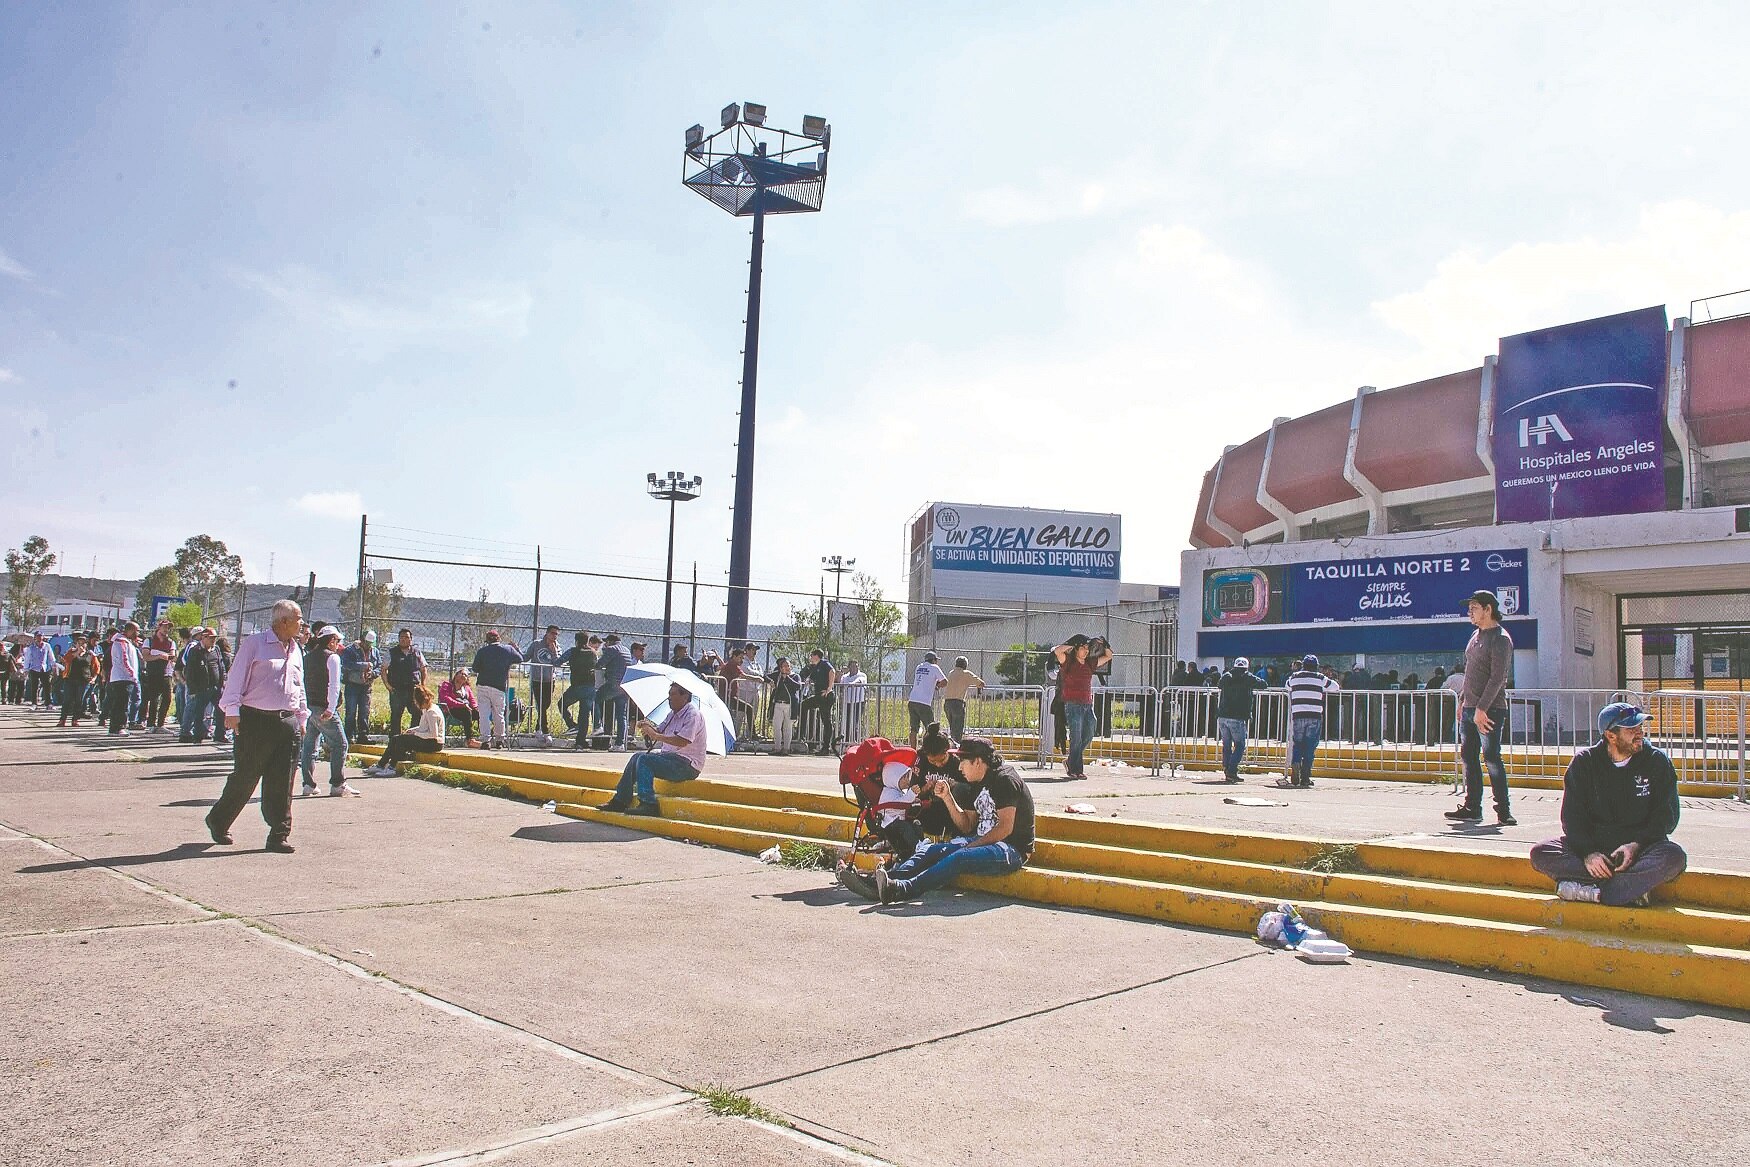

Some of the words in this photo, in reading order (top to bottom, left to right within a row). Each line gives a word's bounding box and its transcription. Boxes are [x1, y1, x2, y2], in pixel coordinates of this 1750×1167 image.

[1519, 413, 1574, 448] HA
[1519, 449, 1592, 471] Hospitales
[1596, 438, 1656, 460] Angeles
[1502, 474, 1544, 488] QUEREMOS
[1545, 473, 1558, 484] UN
[1558, 469, 1592, 482] MEXICO
[1593, 465, 1619, 477] LLENO
[1621, 462, 1633, 473] DE
[1633, 460, 1656, 471] VIDA
[945, 529, 968, 545] UN
[968, 525, 1035, 549] BUEN
[1036, 524, 1111, 549] GALLO
[935, 549, 947, 560] SE
[947, 549, 977, 561] ACTIVA
[978, 550, 990, 561] EN
[991, 549, 1046, 566] UNIDADES
[1048, 551, 1115, 568] DEPORTIVAS
[1306, 564, 1388, 580] TAQUILLA
[1393, 560, 1454, 575] NORTE
[1460, 557, 1471, 572] 2
[1366, 581, 1407, 592] SIEMPRE
[1358, 592, 1412, 610] GALLOS
